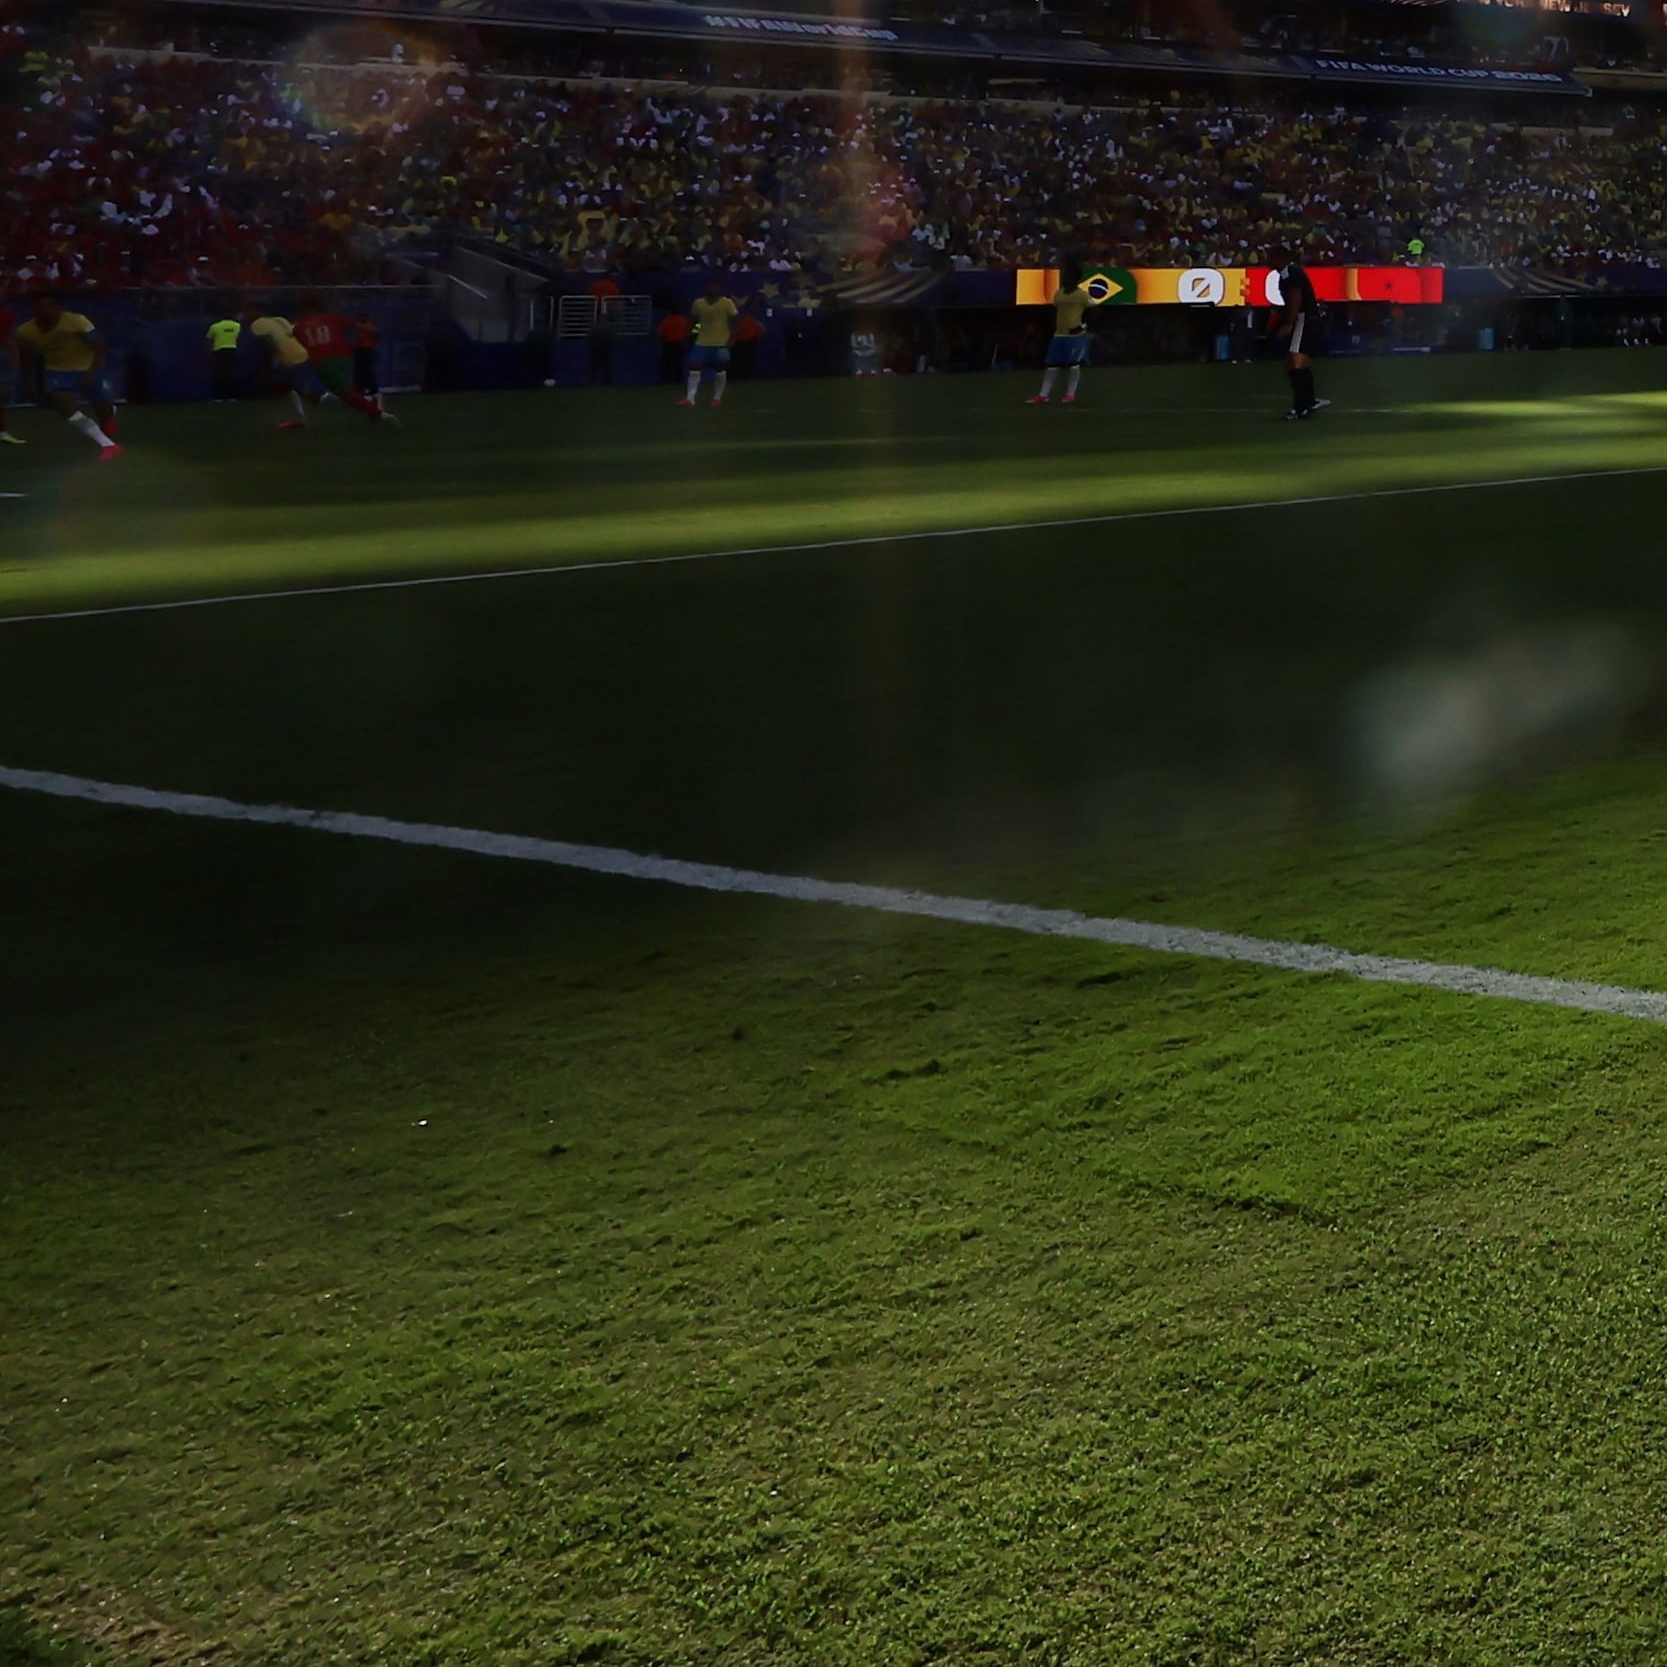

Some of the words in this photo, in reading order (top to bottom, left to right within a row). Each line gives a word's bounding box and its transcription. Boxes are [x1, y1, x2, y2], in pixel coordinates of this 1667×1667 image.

[1573, 1, 1631, 17] JESEY
[1315, 59, 1366, 71] FIFA
[1366, 63, 1446, 76] WORLD
[1447, 68, 1489, 78] CUP
